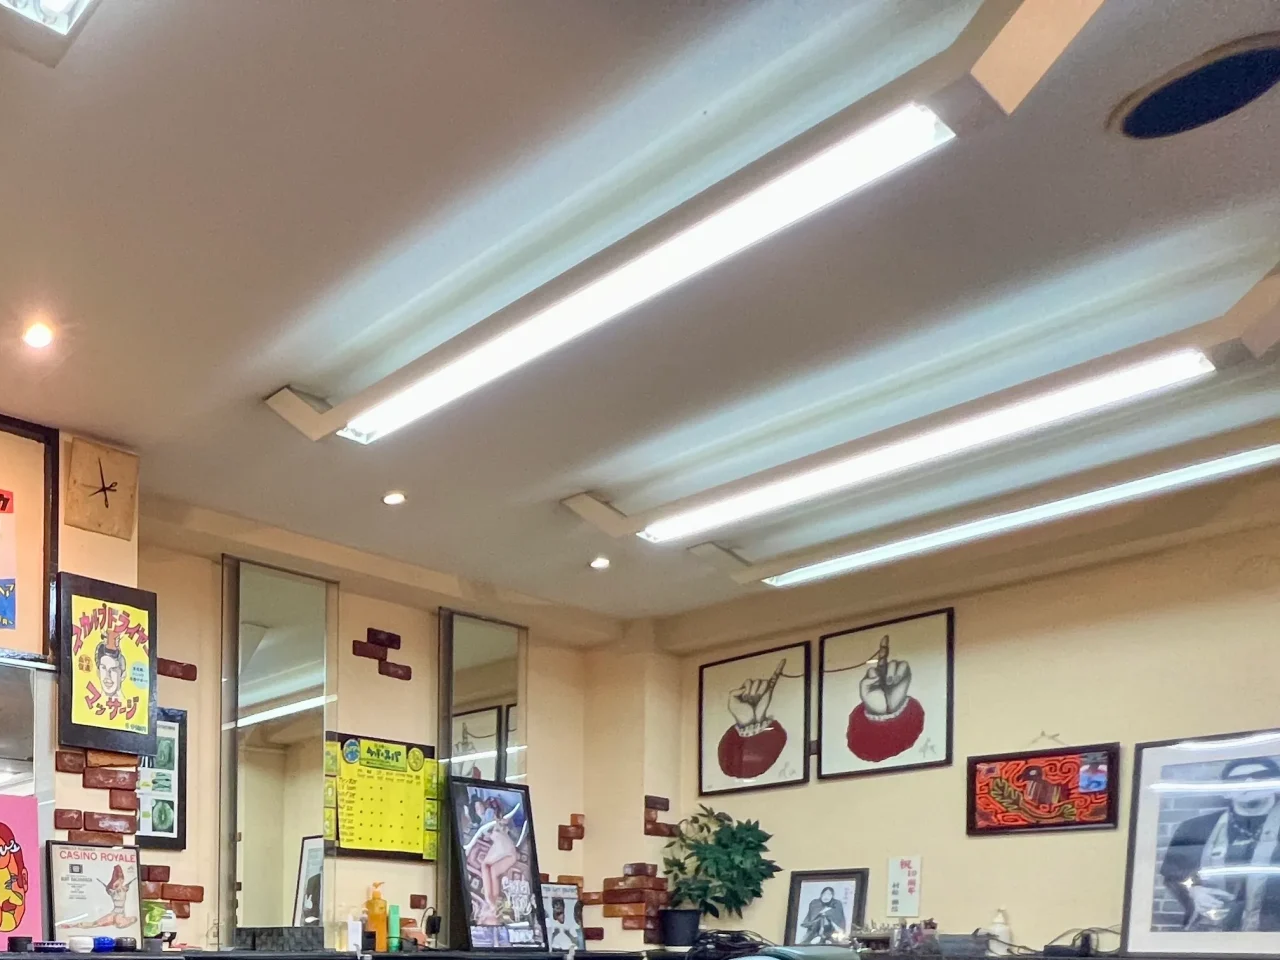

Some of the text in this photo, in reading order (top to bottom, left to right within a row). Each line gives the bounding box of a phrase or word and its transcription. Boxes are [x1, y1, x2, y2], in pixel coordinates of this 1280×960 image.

[84, 681, 140, 721] マッサージ
[59, 850, 137, 863] CASINO ROYALE
